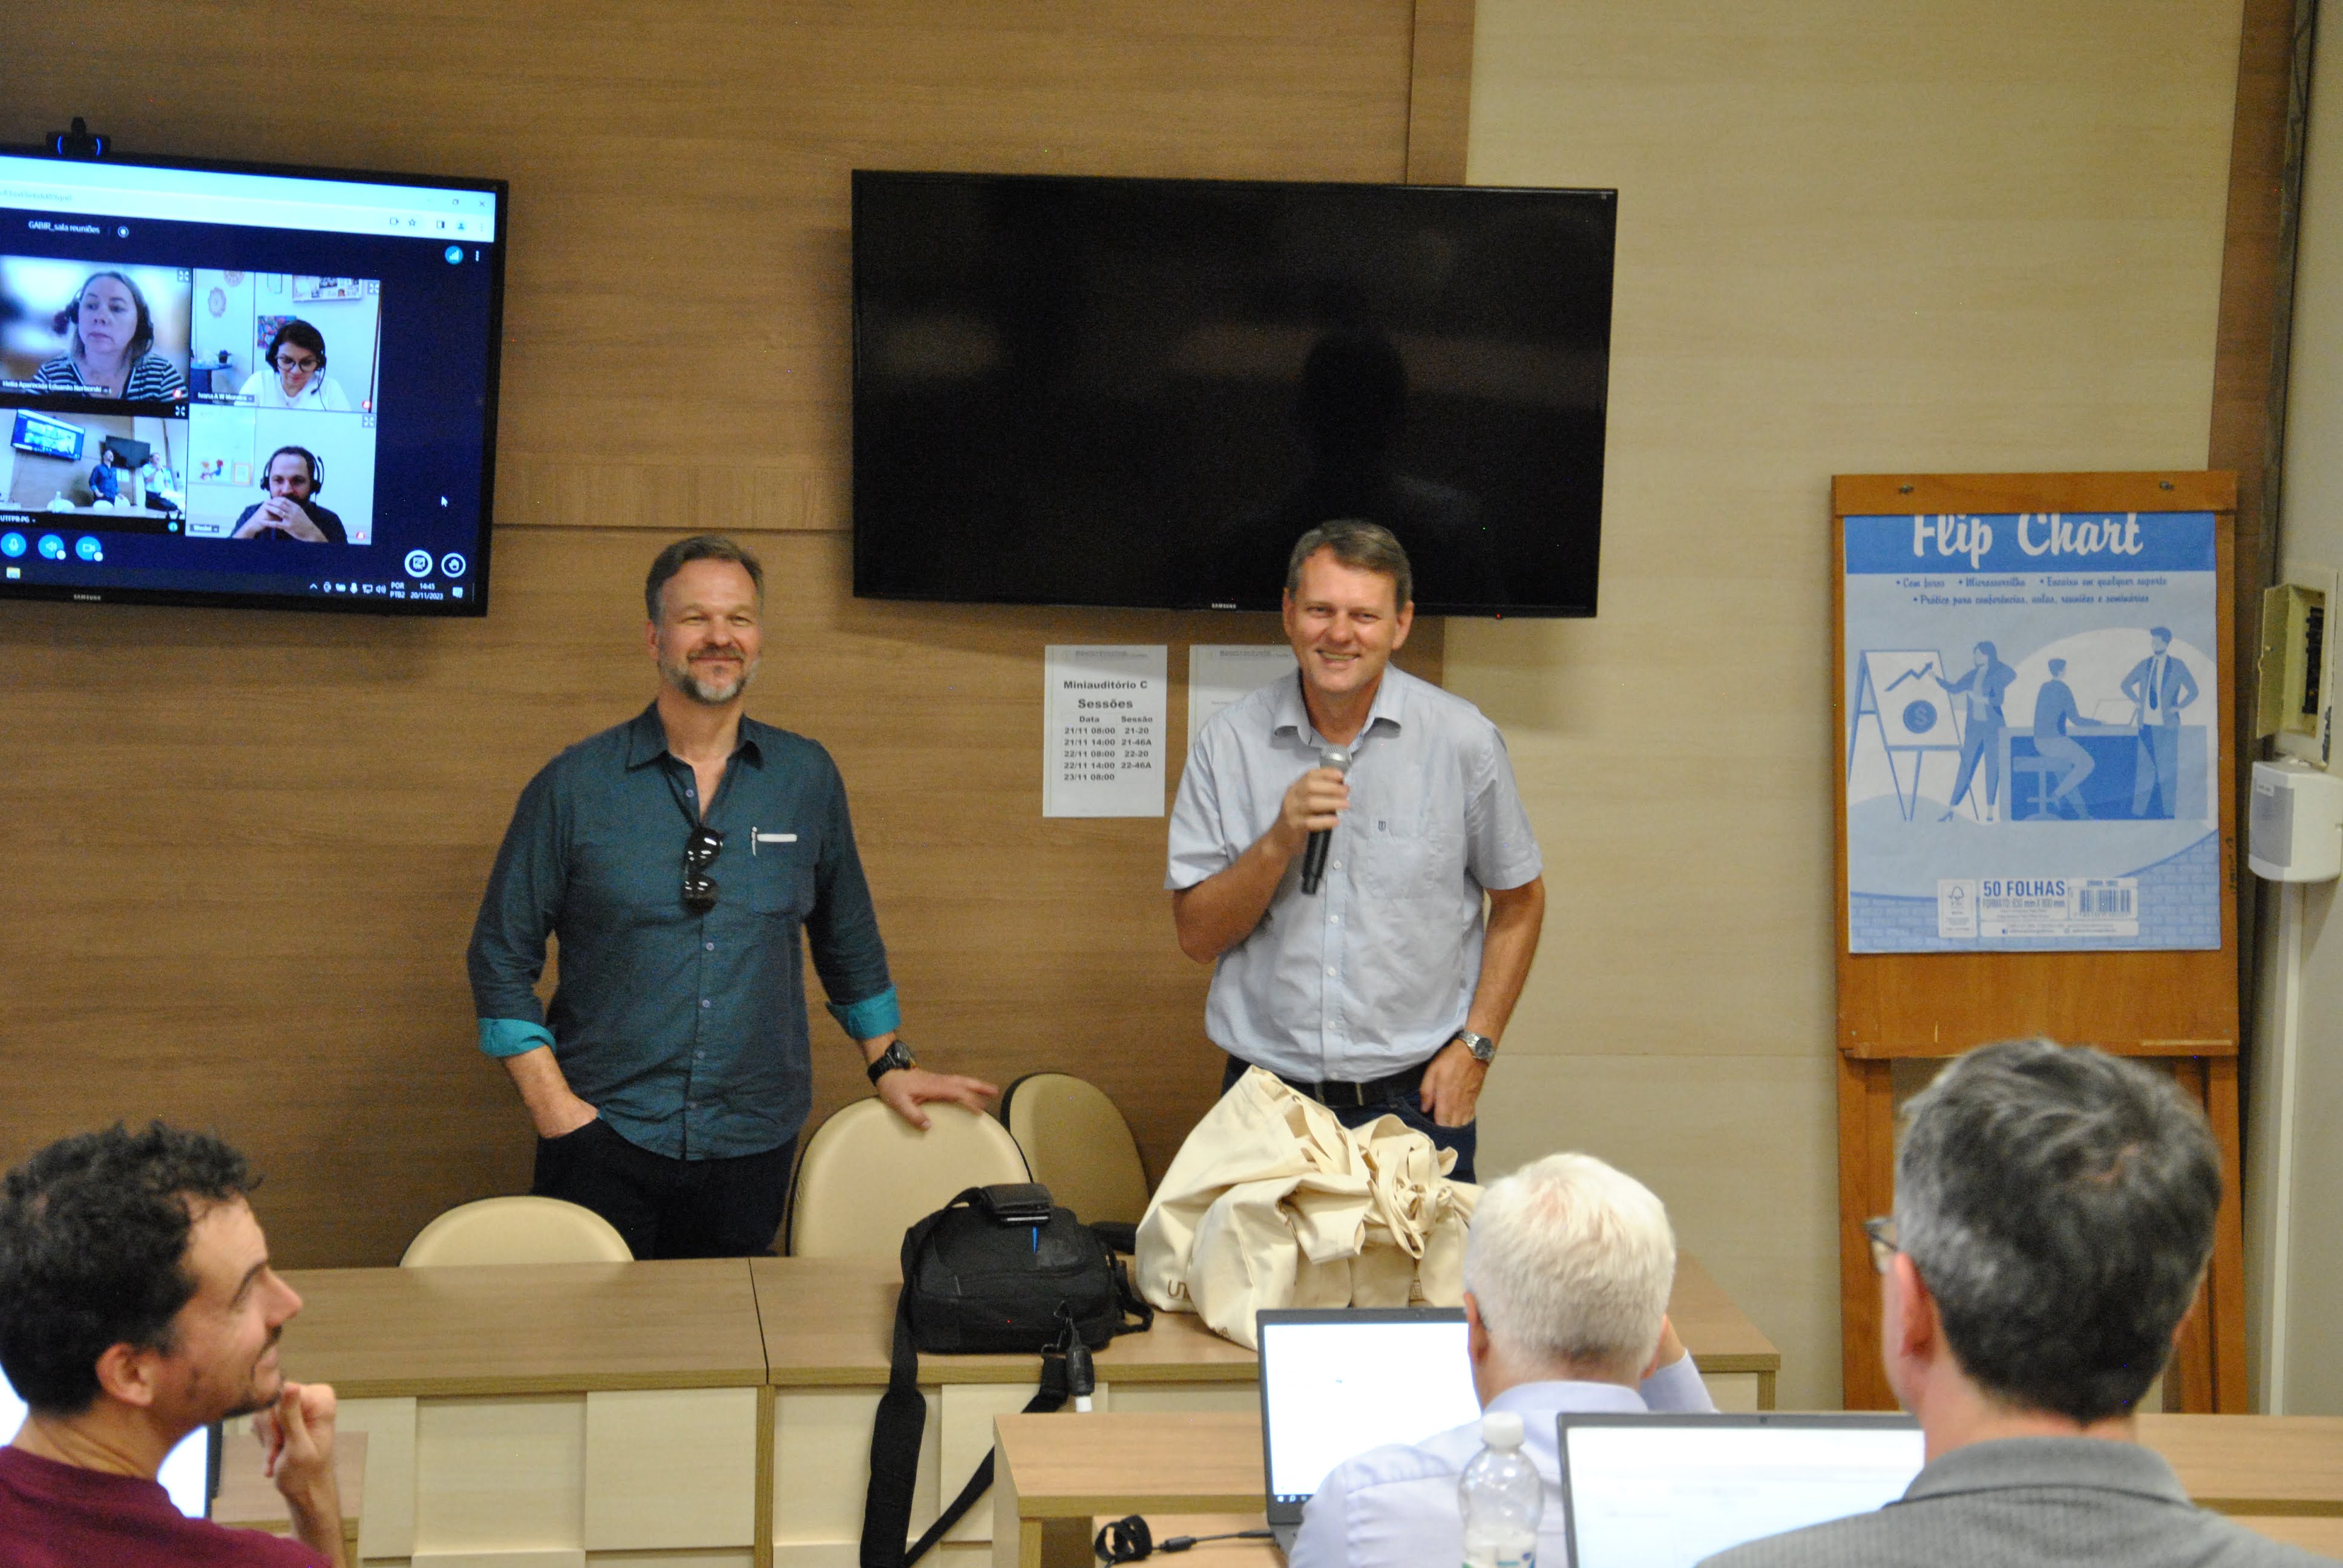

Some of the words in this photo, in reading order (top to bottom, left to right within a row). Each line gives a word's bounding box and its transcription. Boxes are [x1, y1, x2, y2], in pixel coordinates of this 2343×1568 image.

[1913, 515, 1993, 569] Flip
[2017, 512, 2143, 555] Chart
[390, 590, 405, 599] PTB2
[410, 591, 444, 600] 20/11/2023
[1064, 681, 1136, 690] Miniauditório
[1140, 681, 1147, 689] C
[1078, 698, 1133, 708] Sessões
[1984, 881, 2001, 897] 50
[2007, 881, 2065, 897] FOLHAS
